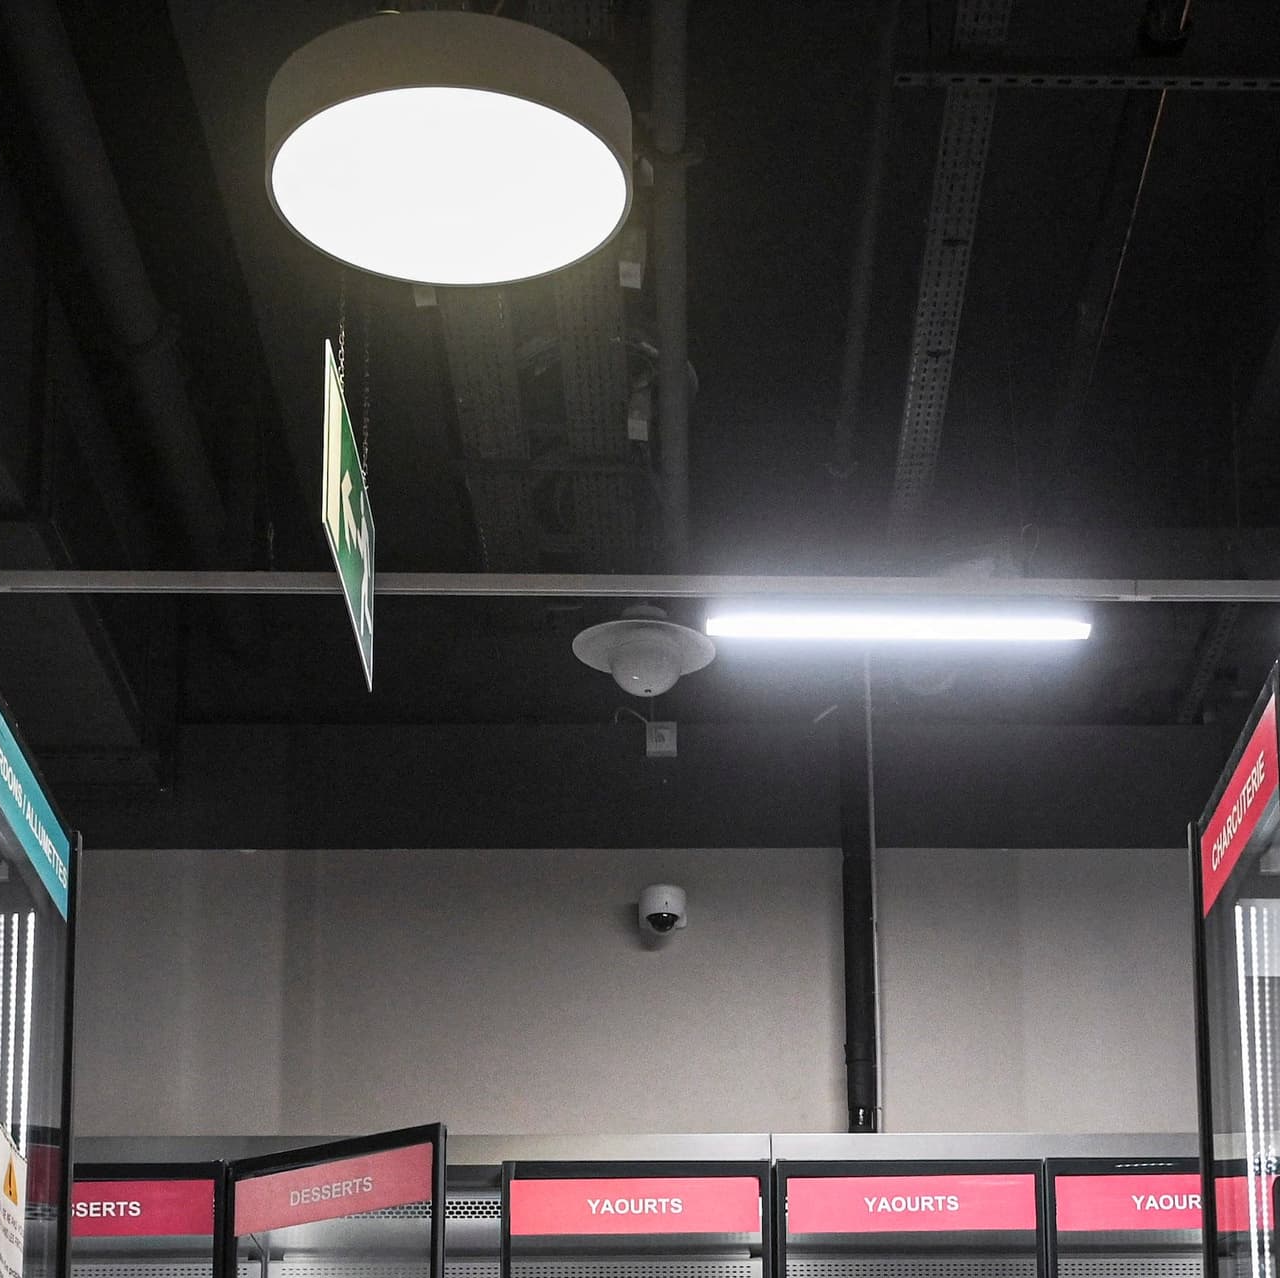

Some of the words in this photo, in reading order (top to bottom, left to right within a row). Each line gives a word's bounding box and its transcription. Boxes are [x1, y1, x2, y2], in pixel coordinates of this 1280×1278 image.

[1211, 751, 1266, 872] CHARCUTERIE
[25, 802, 68, 889] ALLUMETTES
[289, 1176, 373, 1207] DESSERTS
[71, 1201, 141, 1218] SERTS
[586, 1197, 683, 1215] YAOURTS
[863, 1195, 960, 1213] YAOURTS
